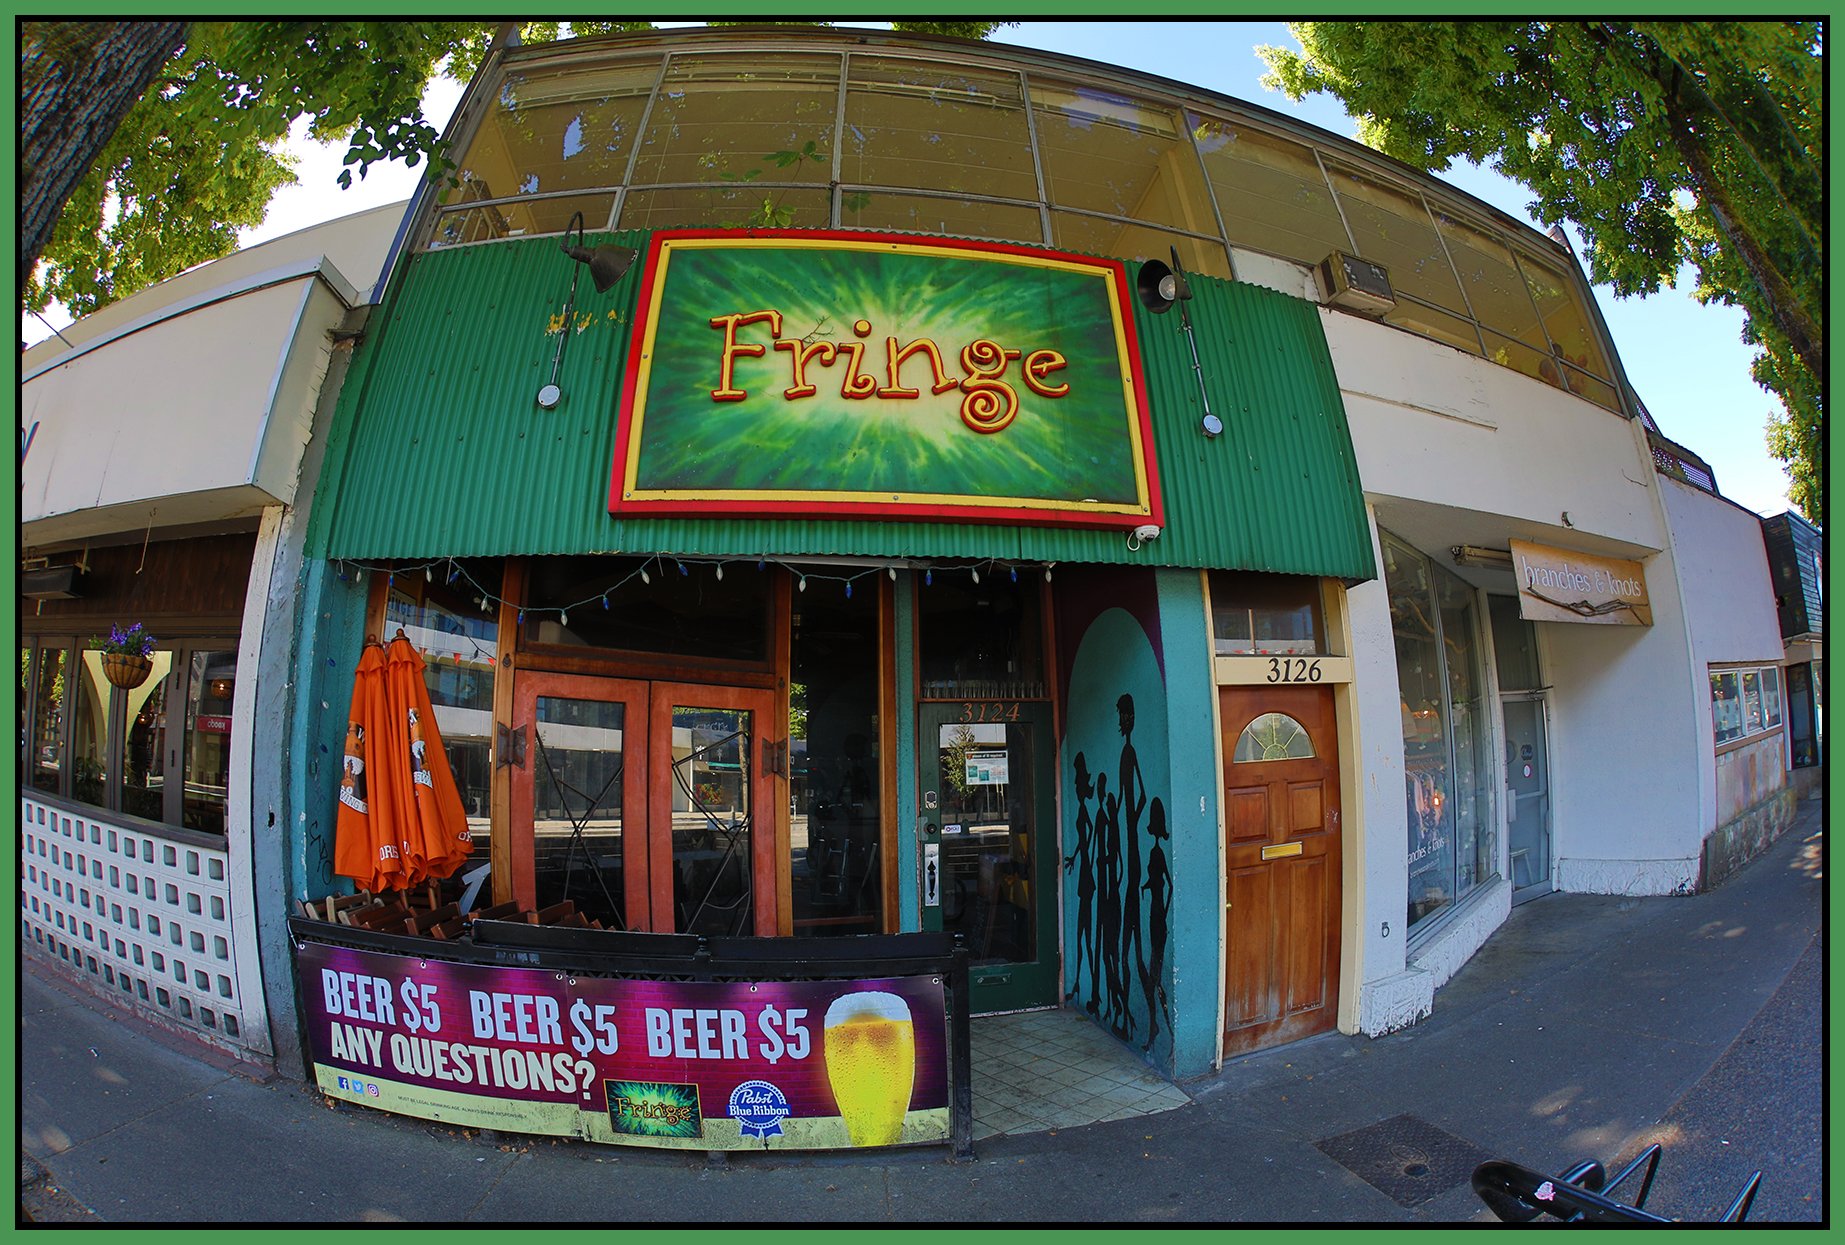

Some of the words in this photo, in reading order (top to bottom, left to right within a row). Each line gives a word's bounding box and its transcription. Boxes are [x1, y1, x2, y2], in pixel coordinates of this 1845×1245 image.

[709, 309, 1070, 434] Fringe
[1522, 555, 1591, 592] branches
[1594, 571, 1605, 593] &
[1606, 570, 1641, 597] knots
[1267, 658, 1322, 683] 3126
[959, 702, 1021, 722] 3124
[321, 968, 397, 1026] BEER
[400, 976, 442, 1034] $5
[469, 989, 564, 1045] BEER
[569, 998, 619, 1058] $5
[645, 1007, 750, 1060] BEER
[757, 1003, 811, 1064] $5
[331, 1021, 384, 1068] ANY
[390, 1033, 596, 1100] QUESTIONS?
[729, 1104, 752, 1116] Blue
[752, 1104, 790, 1116] Ribbon
[741, 1088, 774, 1104] Pabst
[614, 1097, 692, 1126] Fringe
